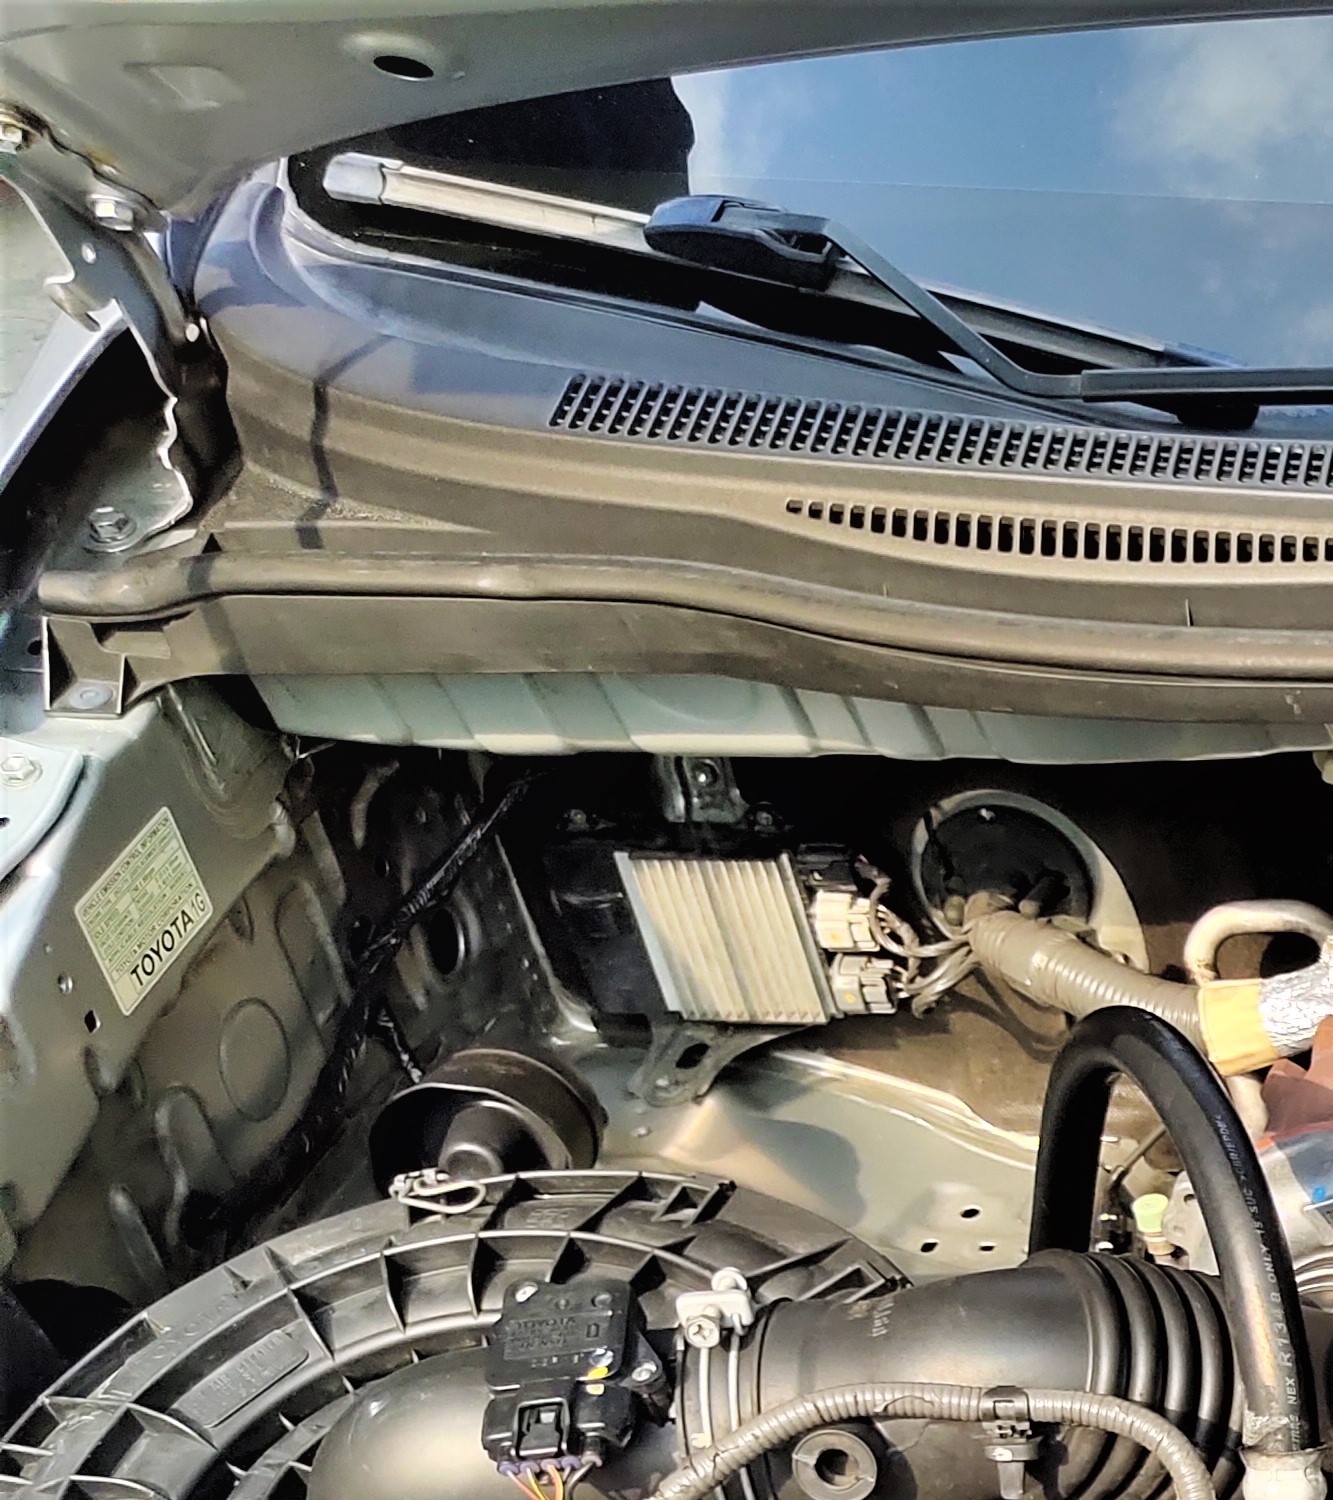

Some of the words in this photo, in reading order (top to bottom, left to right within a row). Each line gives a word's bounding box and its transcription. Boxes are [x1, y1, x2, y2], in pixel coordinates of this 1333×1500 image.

[131, 909, 194, 986] TOYOTA
[1260, 1243, 1277, 1283] ONLY
[1285, 1377, 1297, 1405] NEX
